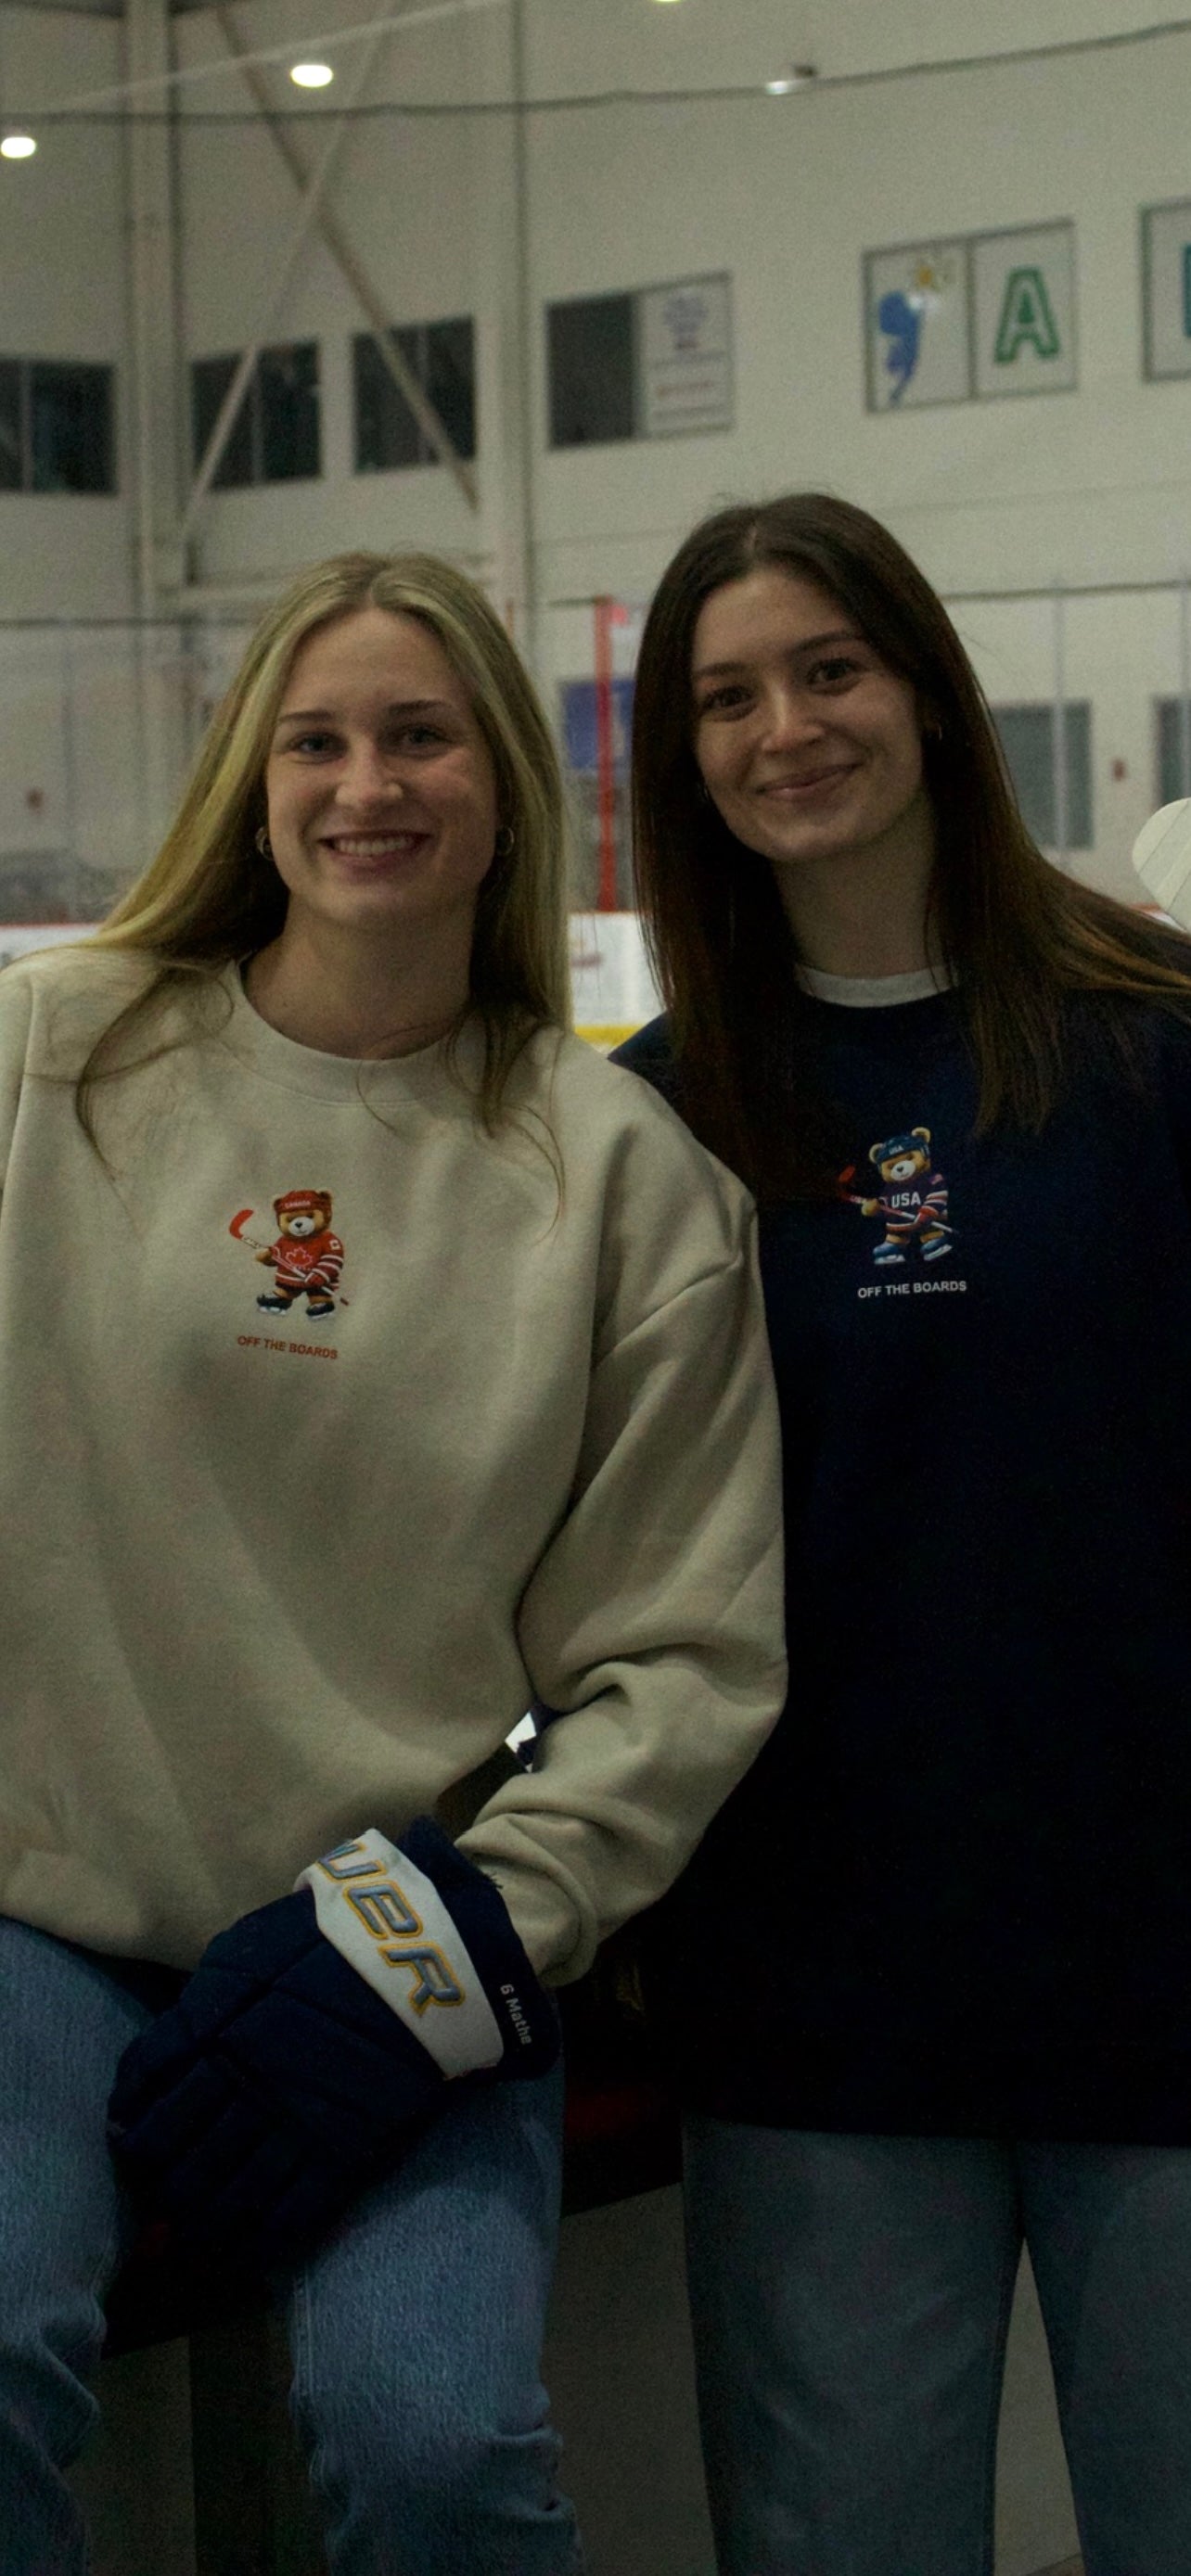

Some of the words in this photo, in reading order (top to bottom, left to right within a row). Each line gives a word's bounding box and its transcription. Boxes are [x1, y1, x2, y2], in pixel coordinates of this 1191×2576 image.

[993, 266, 1061, 363] A
[891, 1191, 921, 1208] USA
[857, 1285, 882, 1298] OFF
[885, 1283, 910, 1296] THE
[913, 1280, 967, 1294] BOARDS
[237, 1335, 261, 1346] OFF
[263, 1338, 287, 1352] THE
[289, 1343, 338, 1359] BOARDS
[500, 1983, 515, 1996] 6
